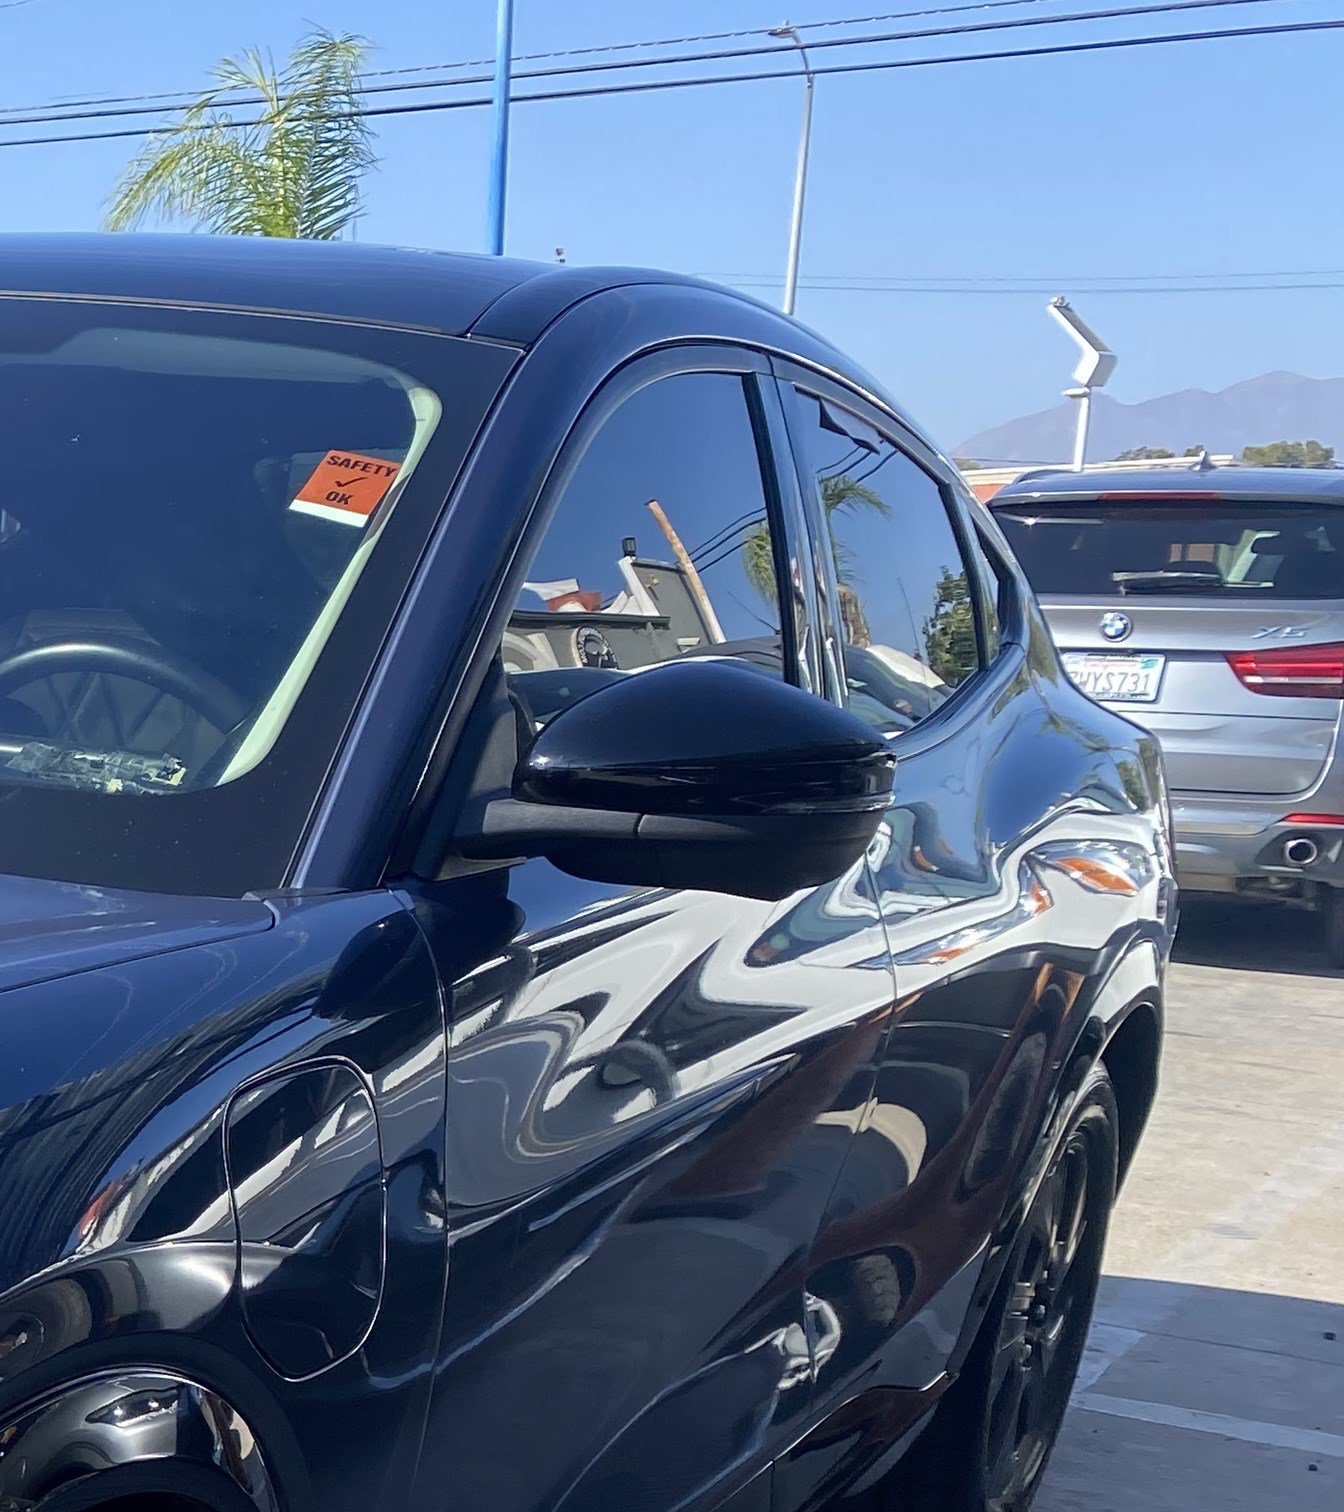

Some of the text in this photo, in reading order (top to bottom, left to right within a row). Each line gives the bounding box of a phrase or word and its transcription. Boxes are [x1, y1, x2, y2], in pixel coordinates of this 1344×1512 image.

[327, 455, 397, 477] SAFETY
[325, 490, 353, 505] OK
[1251, 626, 1310, 639] X5
